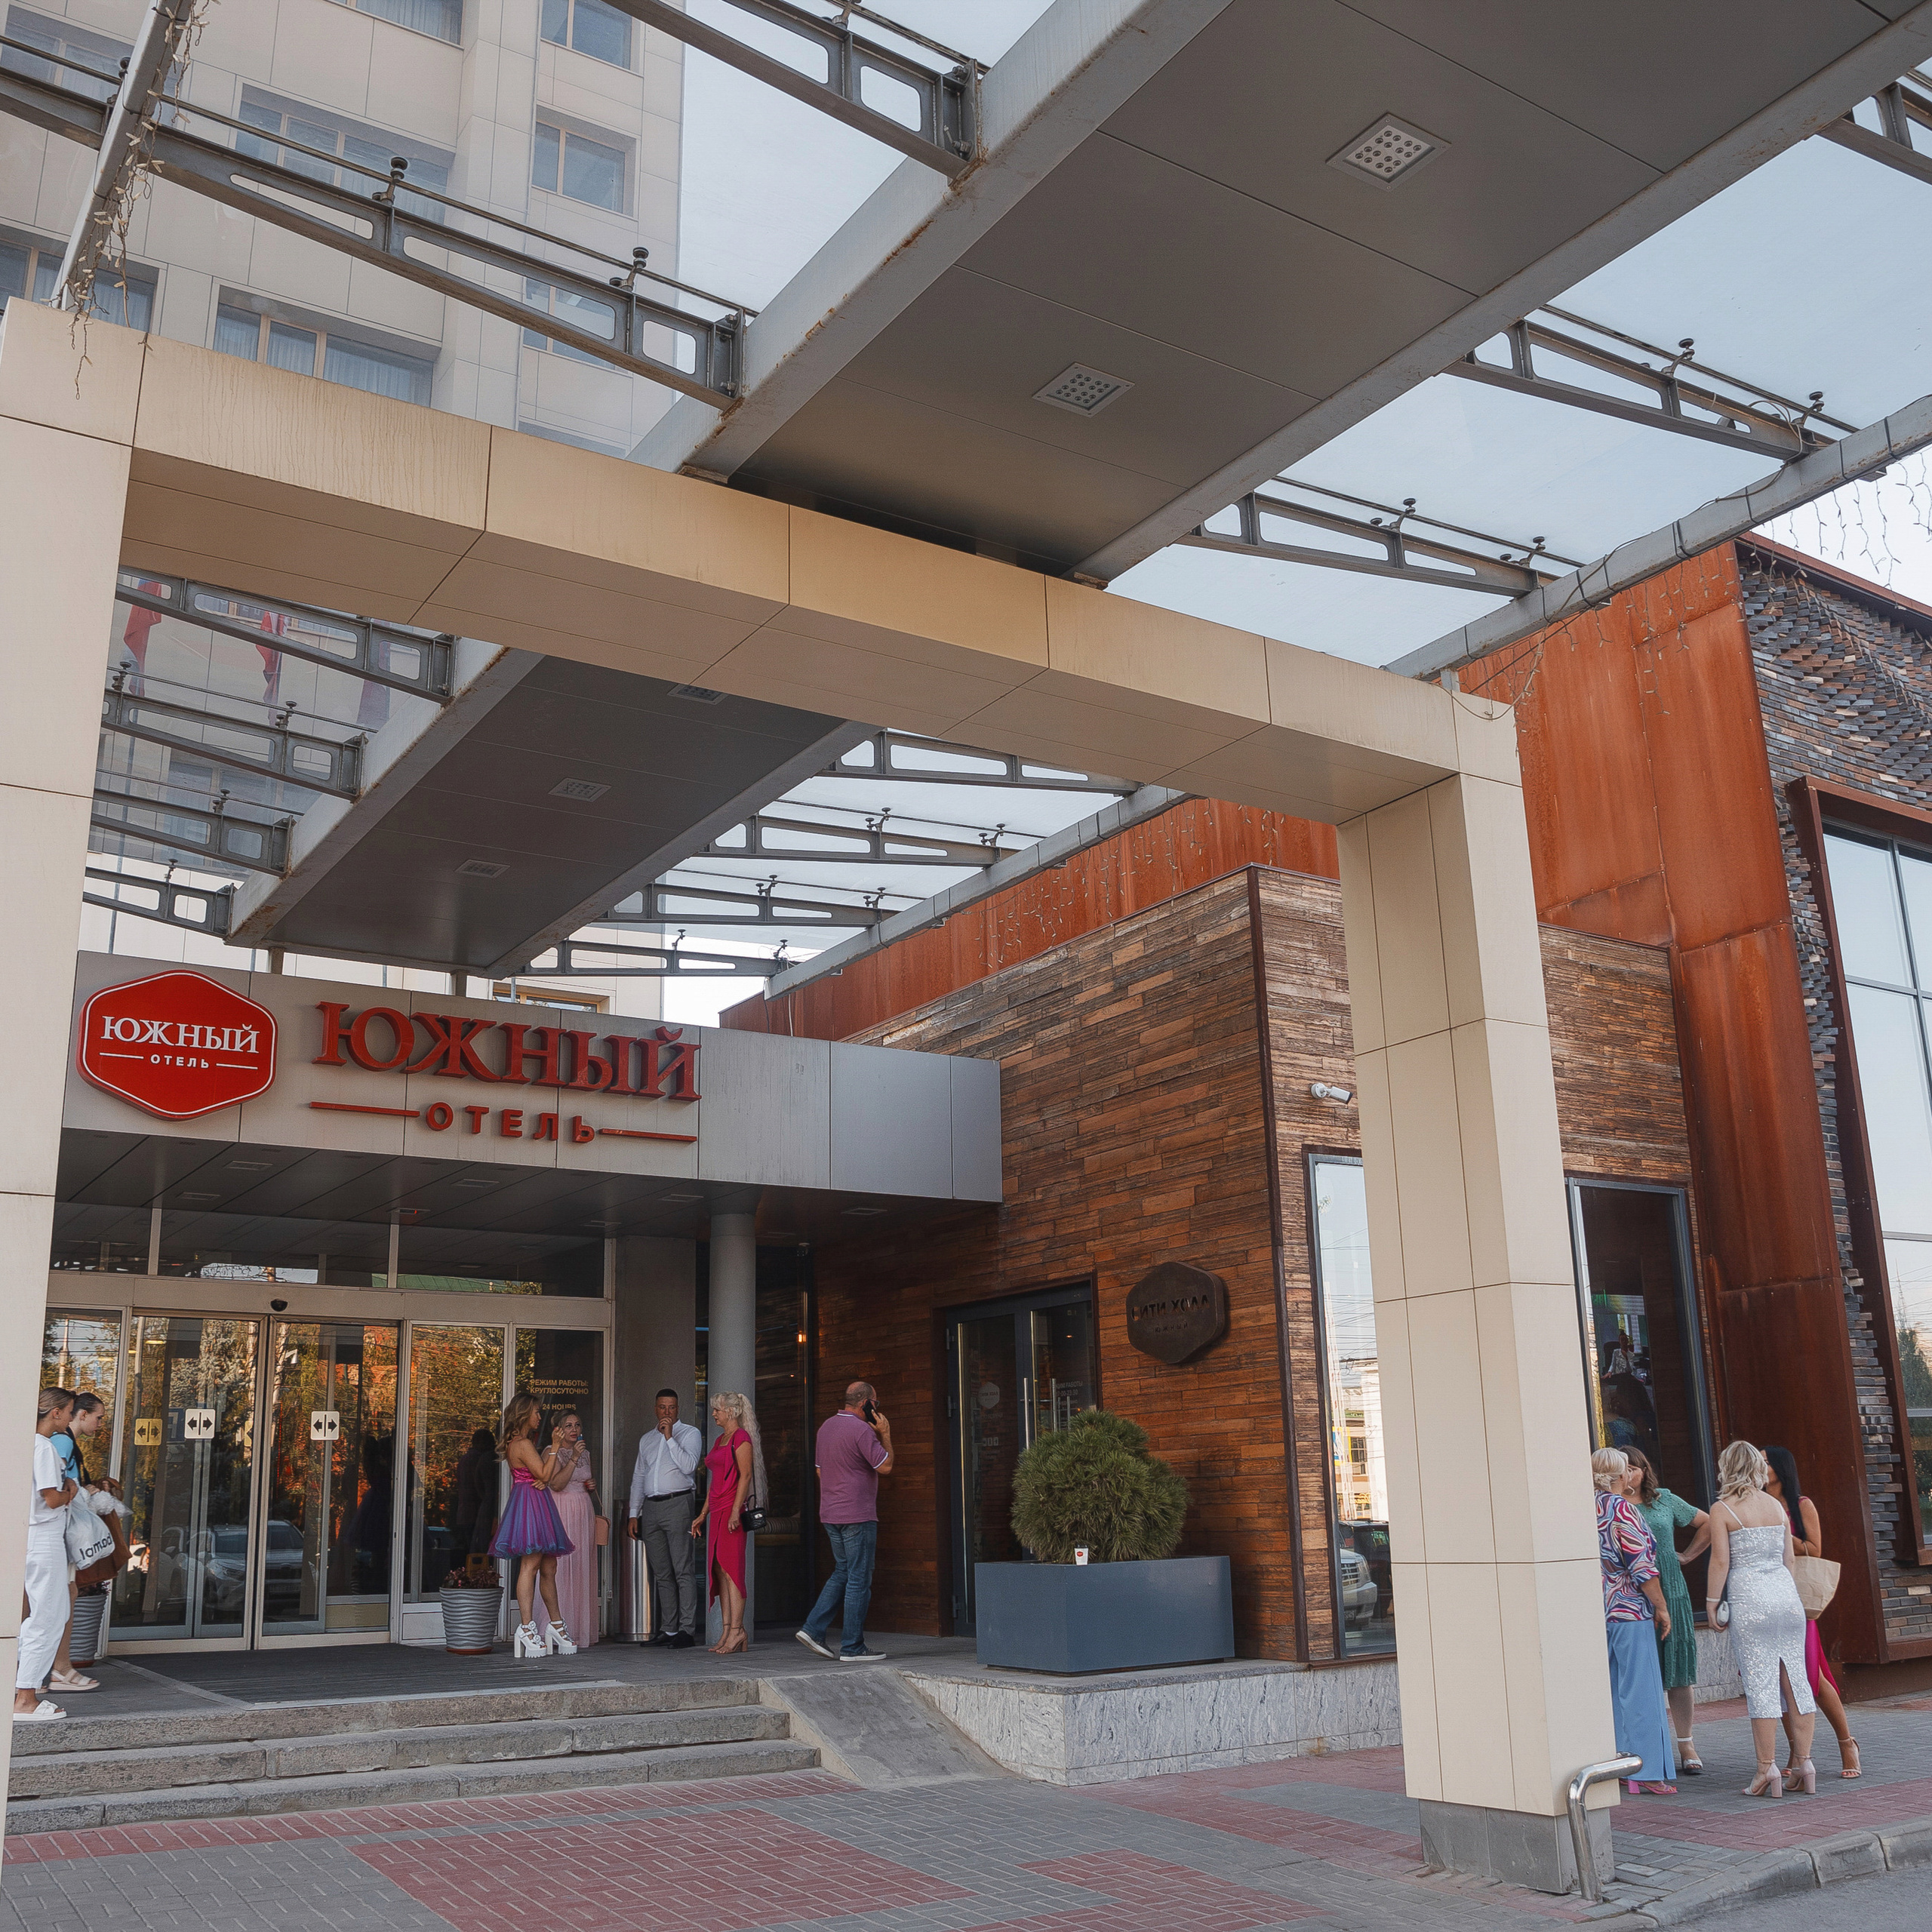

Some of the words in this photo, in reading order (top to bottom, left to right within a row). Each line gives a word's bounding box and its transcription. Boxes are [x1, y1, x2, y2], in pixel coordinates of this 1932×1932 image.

[100, 1016, 260, 1054] ЮЖНЫЙ
[150, 1054, 210, 1069] ОТЕЛЬ
[312, 1001, 703, 1102] ЮЖНЫЙ
[426, 1101, 595, 1144] ОТЕЛЬ
[1131, 1302, 1166, 1321] СИТИ
[1155, 1321, 1188, 1333] ЮЖНЫЙ
